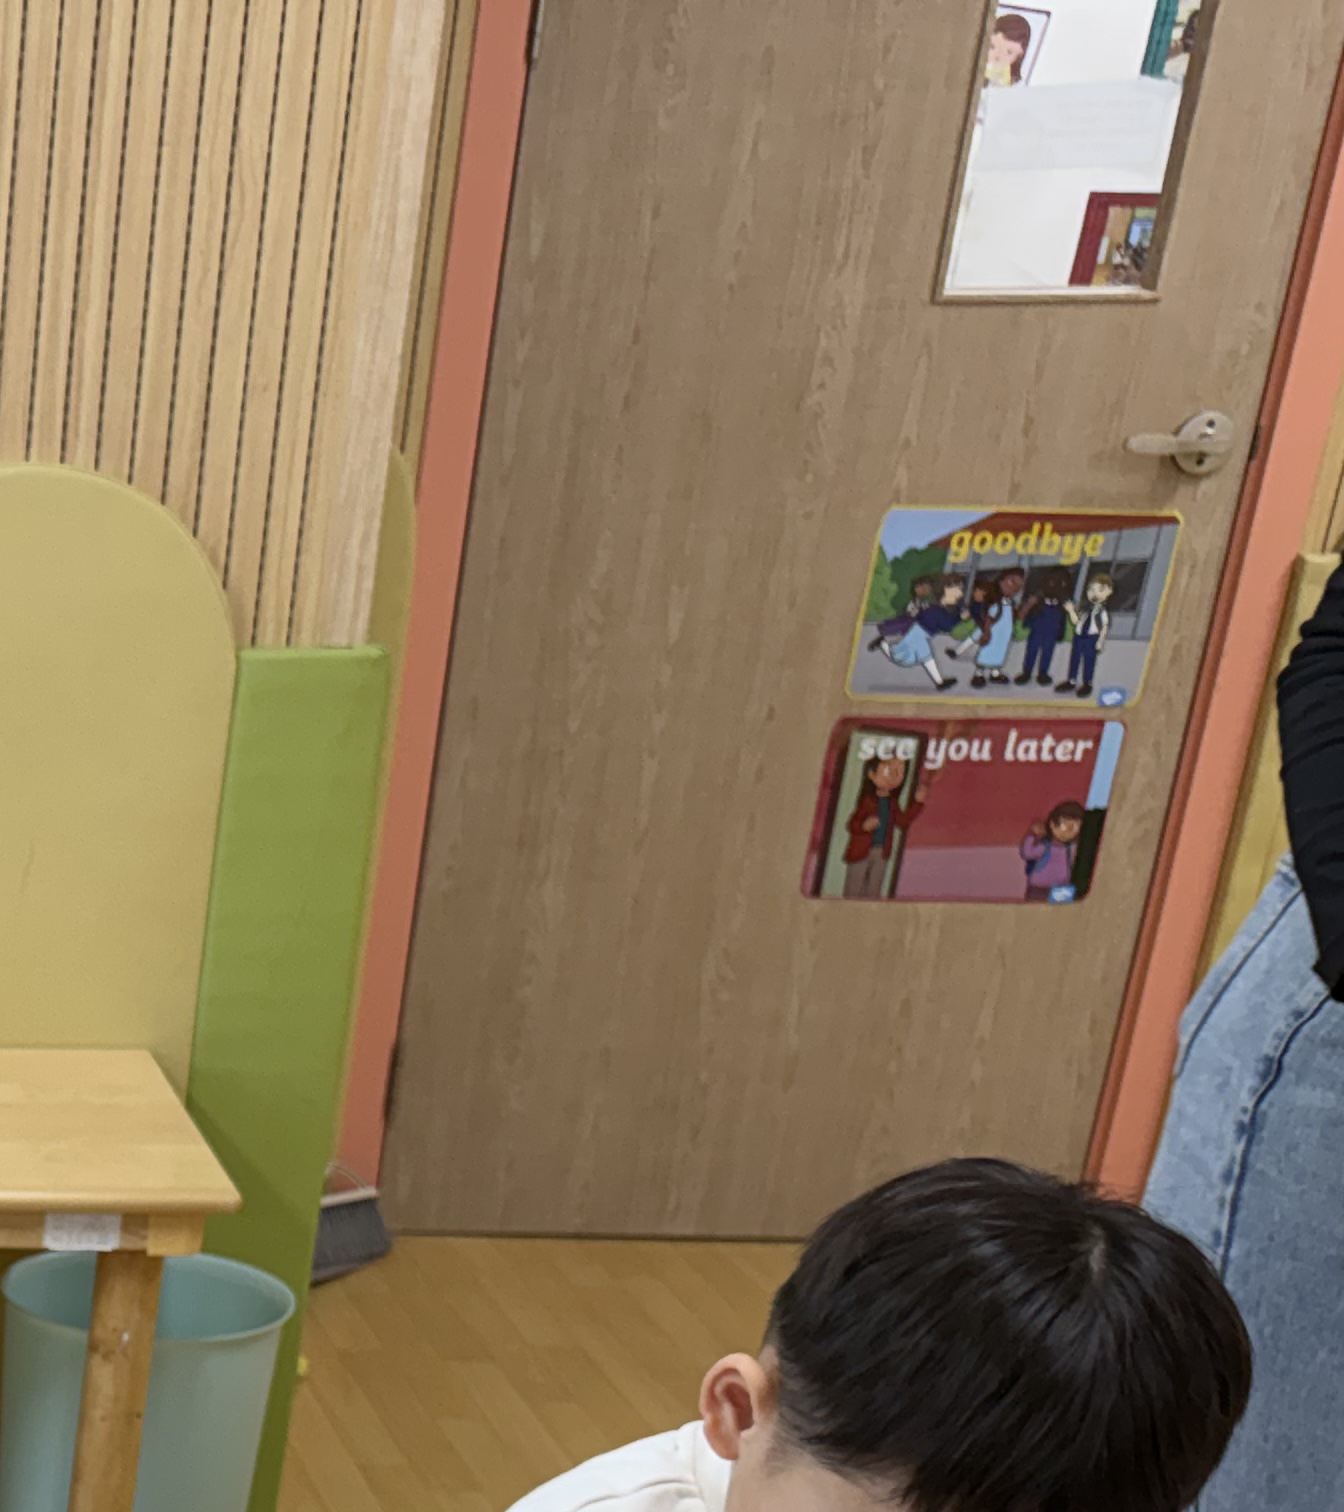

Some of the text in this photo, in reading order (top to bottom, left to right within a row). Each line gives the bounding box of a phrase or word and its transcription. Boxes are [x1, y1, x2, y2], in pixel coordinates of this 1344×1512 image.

[948, 522, 1104, 565] goodbye
[857, 729, 1094, 769] see you later
